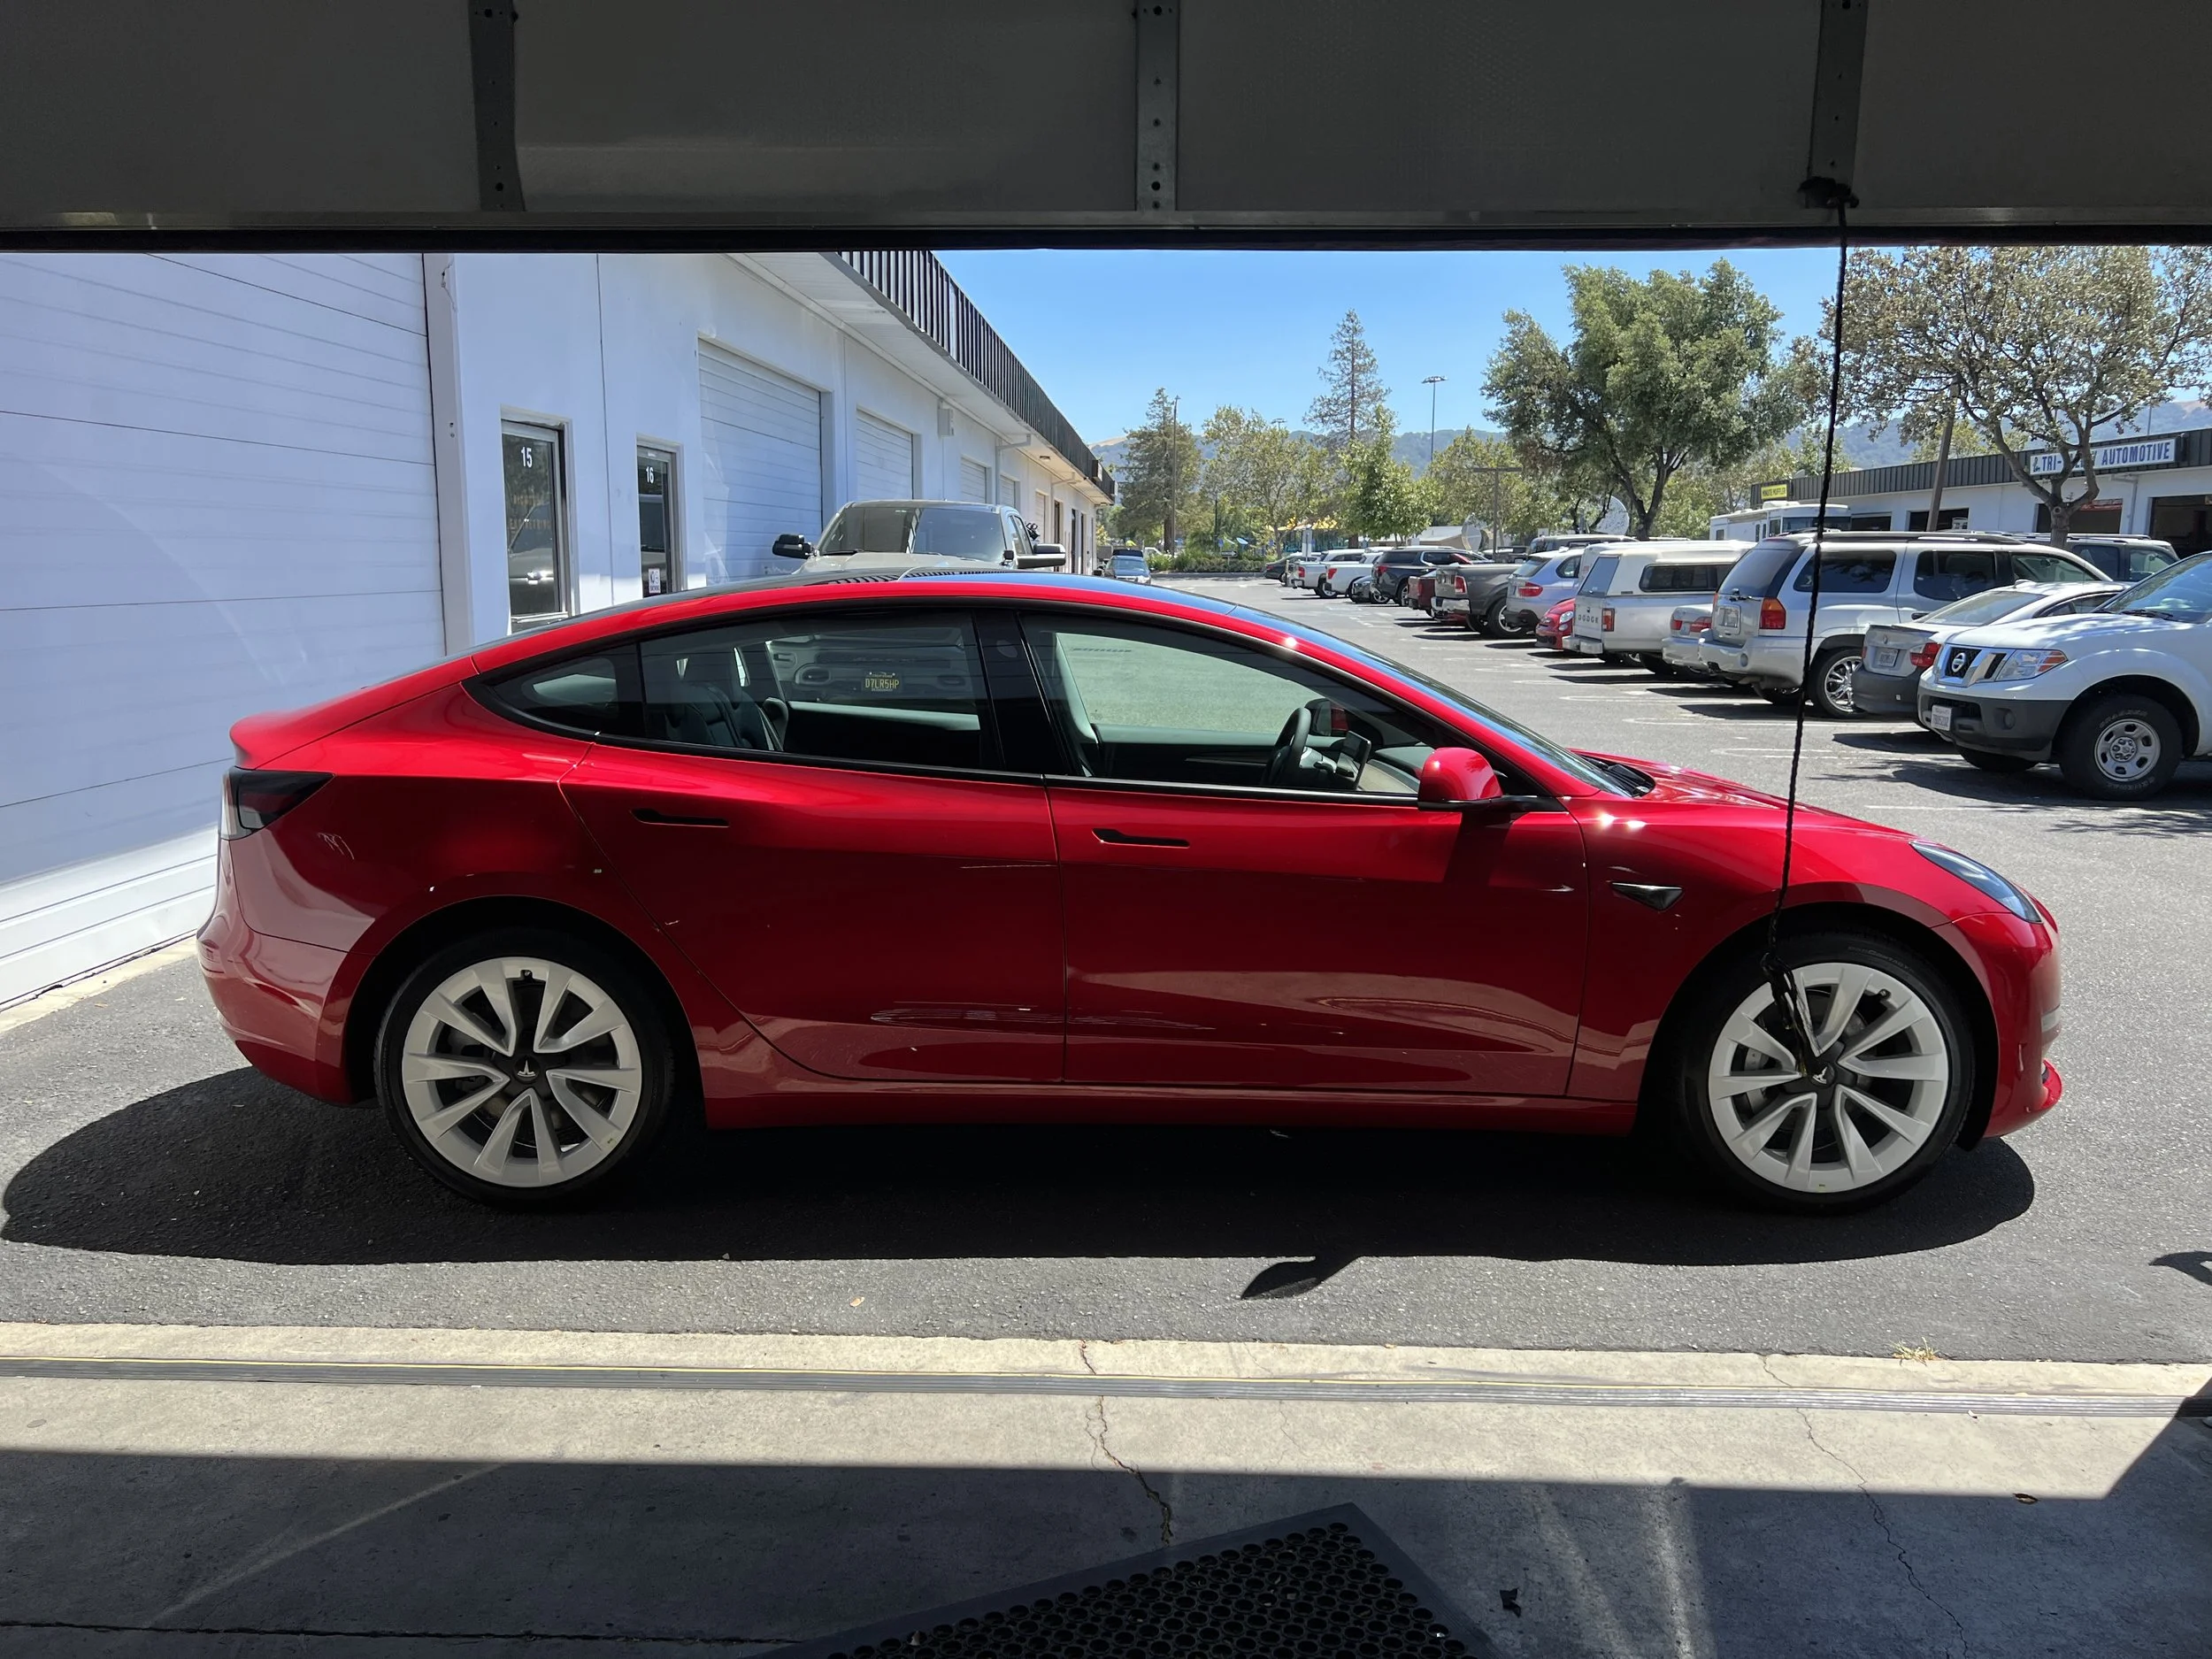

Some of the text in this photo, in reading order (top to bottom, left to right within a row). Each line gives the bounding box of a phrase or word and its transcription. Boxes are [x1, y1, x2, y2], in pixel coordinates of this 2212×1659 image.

[521, 446, 533, 468] 15
[2101, 442, 2170, 465] AUTOMOTIVE
[646, 466, 654, 484] 16
[1578, 614, 1599, 624] DODGE
